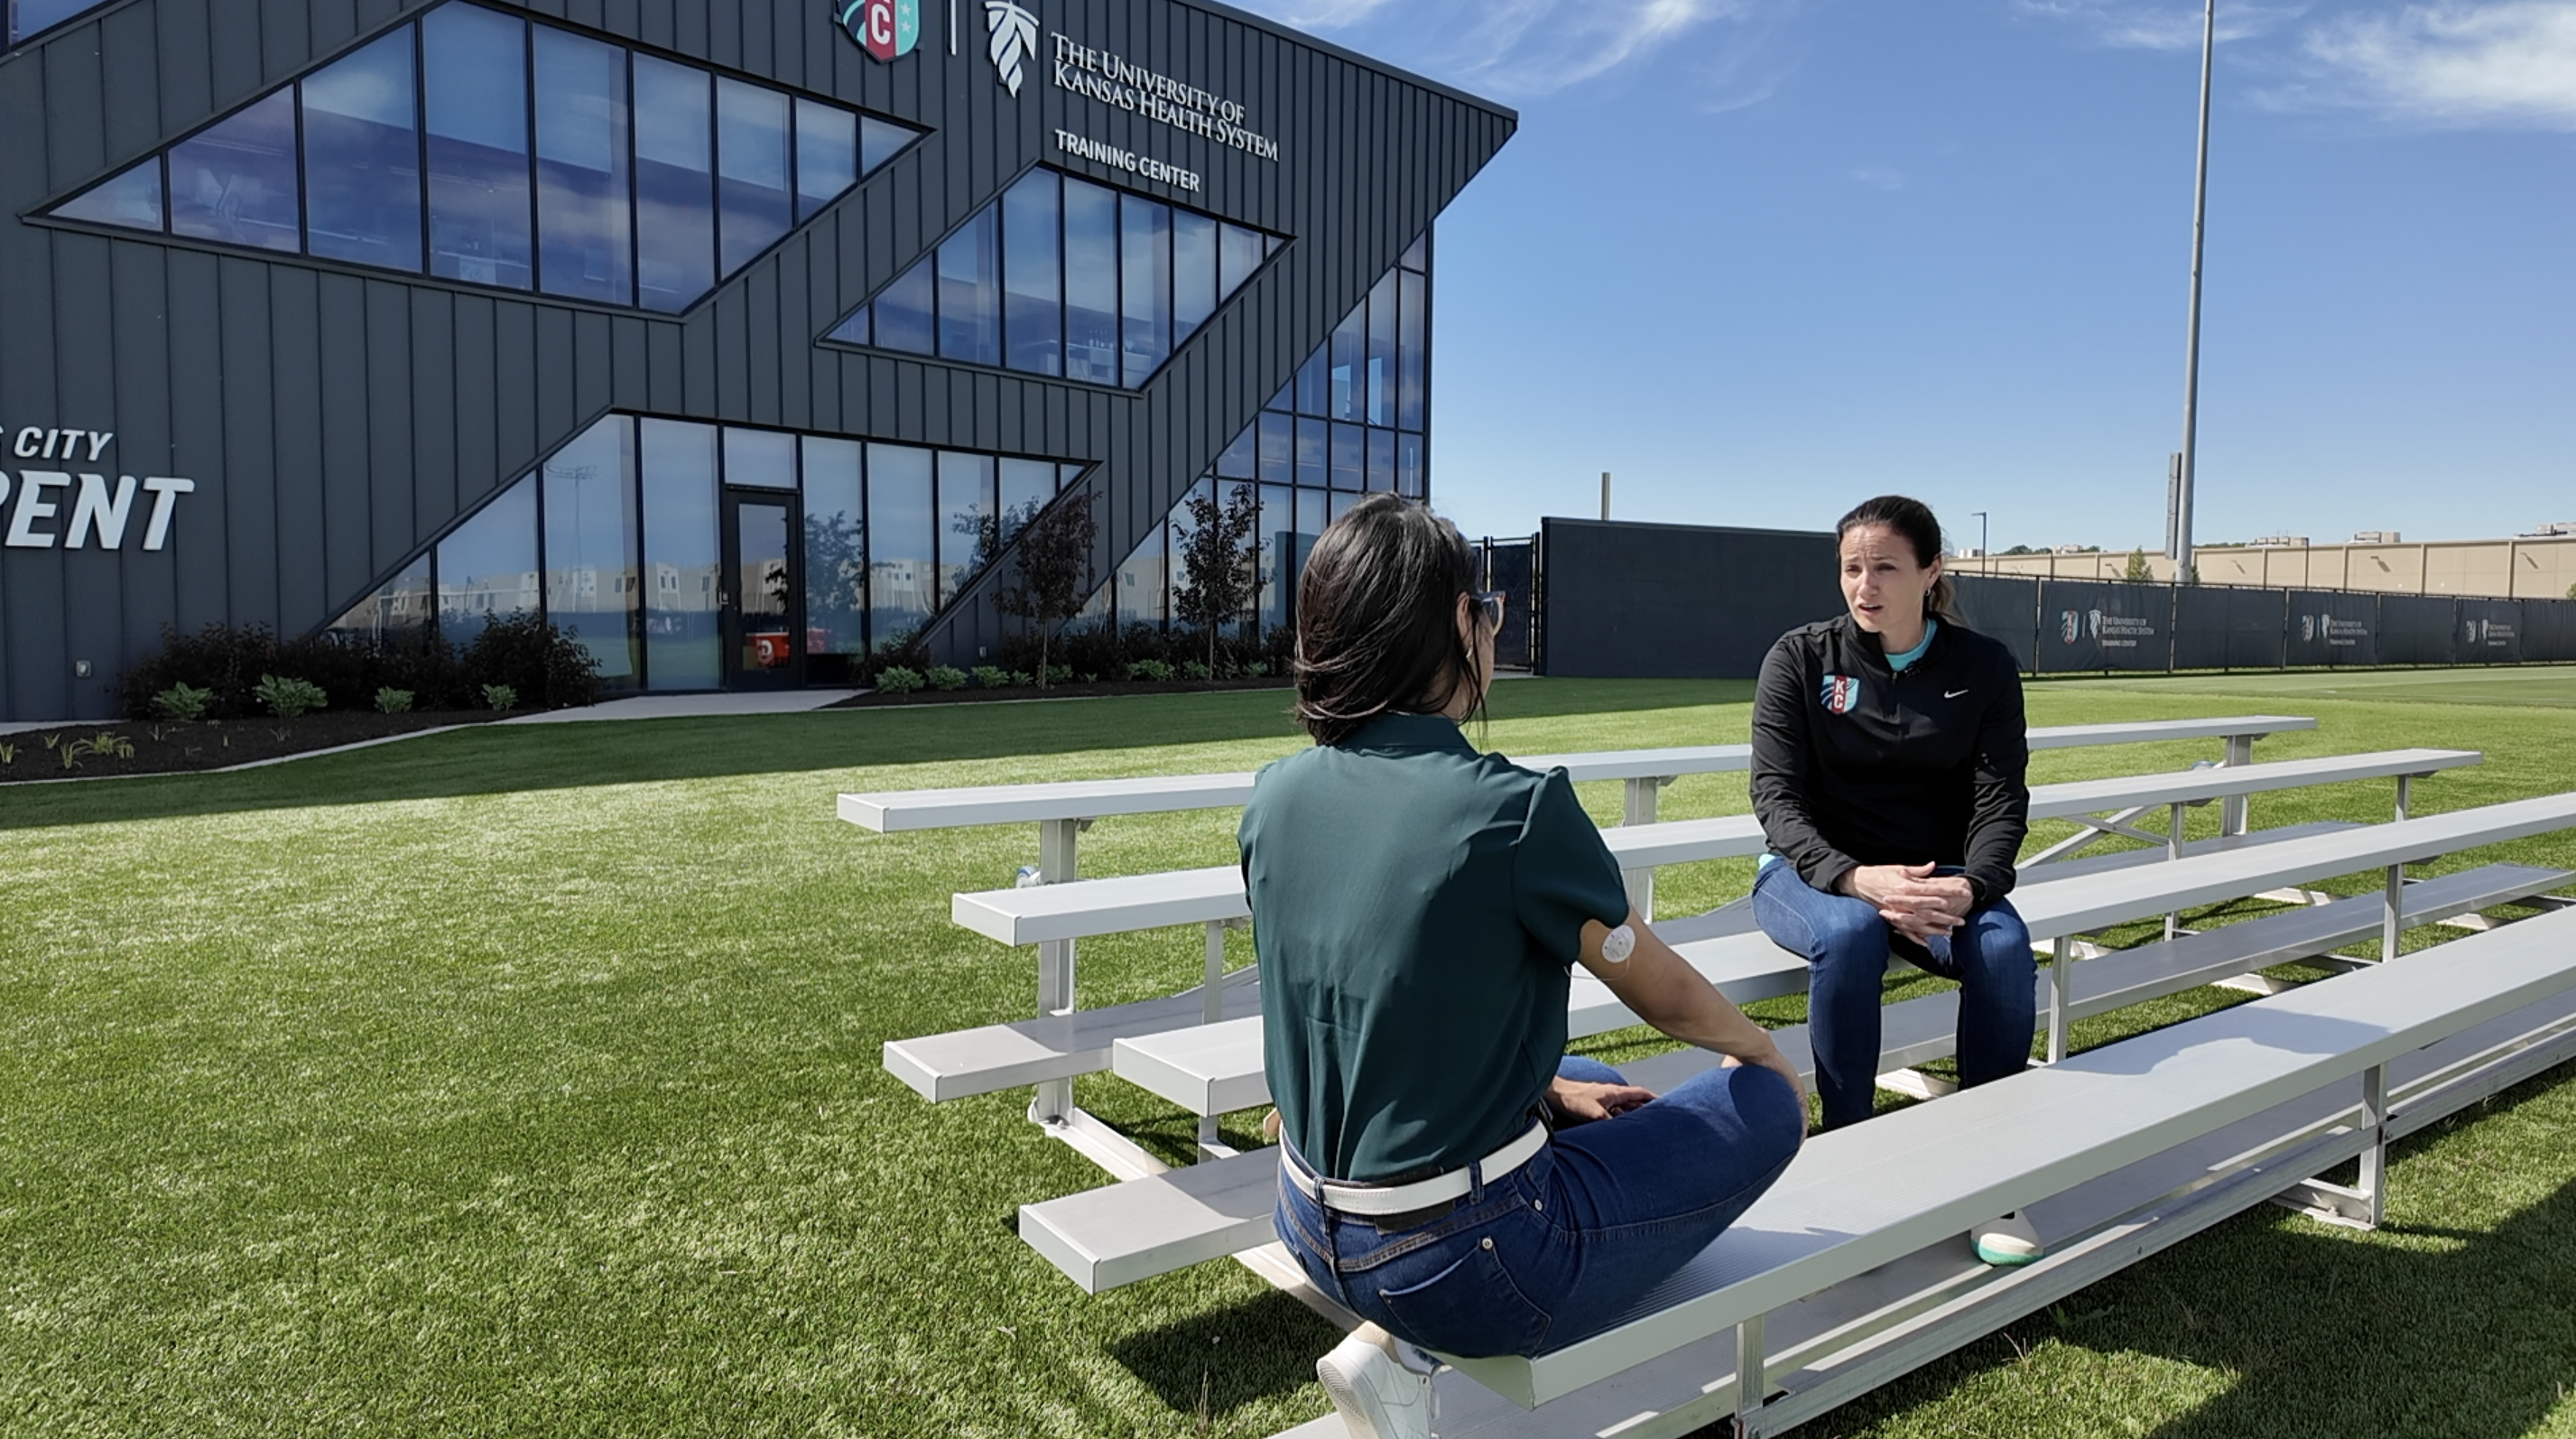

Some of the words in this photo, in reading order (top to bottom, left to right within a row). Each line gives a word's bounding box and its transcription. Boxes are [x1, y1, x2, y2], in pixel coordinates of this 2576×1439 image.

[871, 0, 891, 45] C
[1051, 32, 1097, 72] THE
[1102, 50, 1219, 116] UNIVERSITY
[1220, 100, 1245, 125] OF
[1054, 60, 1135, 110] KANSAS
[1140, 89, 1212, 139] HEALTH
[1216, 119, 1279, 162] SYSTEM
[1055, 129, 1136, 172] TRAINING
[1139, 156, 1200, 192] CENTER
[14, 426, 114, 461] CITY
[0, 469, 196, 551] ENT
[1833, 680, 1845, 709] KC
